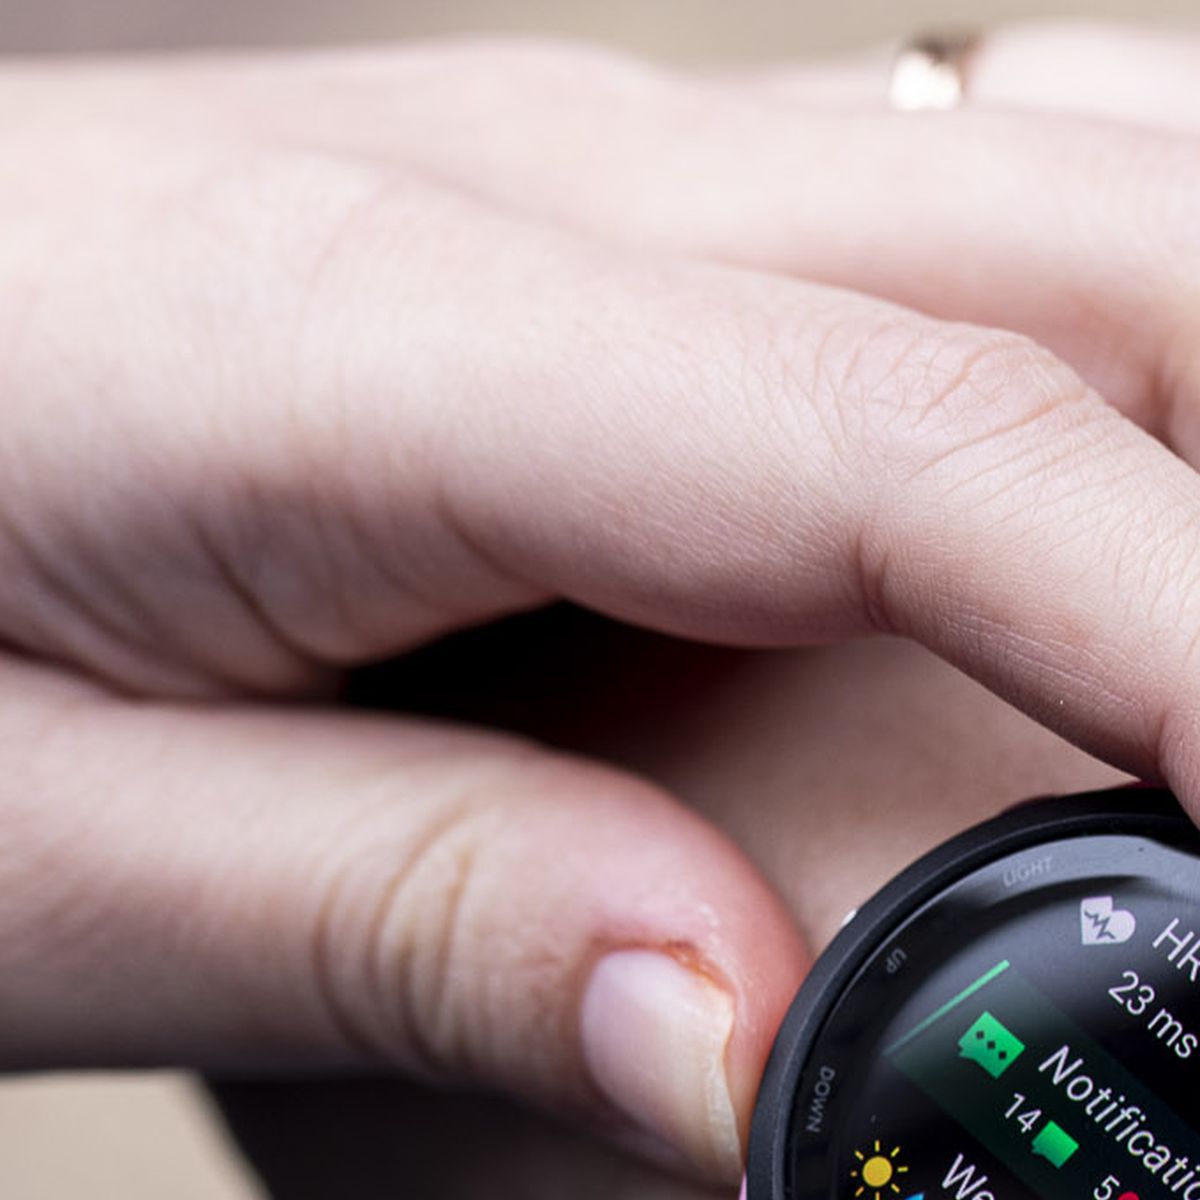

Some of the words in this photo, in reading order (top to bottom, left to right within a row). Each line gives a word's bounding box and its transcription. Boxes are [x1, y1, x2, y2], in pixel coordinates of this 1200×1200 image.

[1003, 855, 1053, 888] LIGHT
[885, 948, 907, 973] UP
[1108, 970, 1155, 1015] 23
[1147, 1009, 1198, 1058] ms
[805, 1065, 836, 1132] DOWN
[1005, 1093, 1042, 1133] 14
